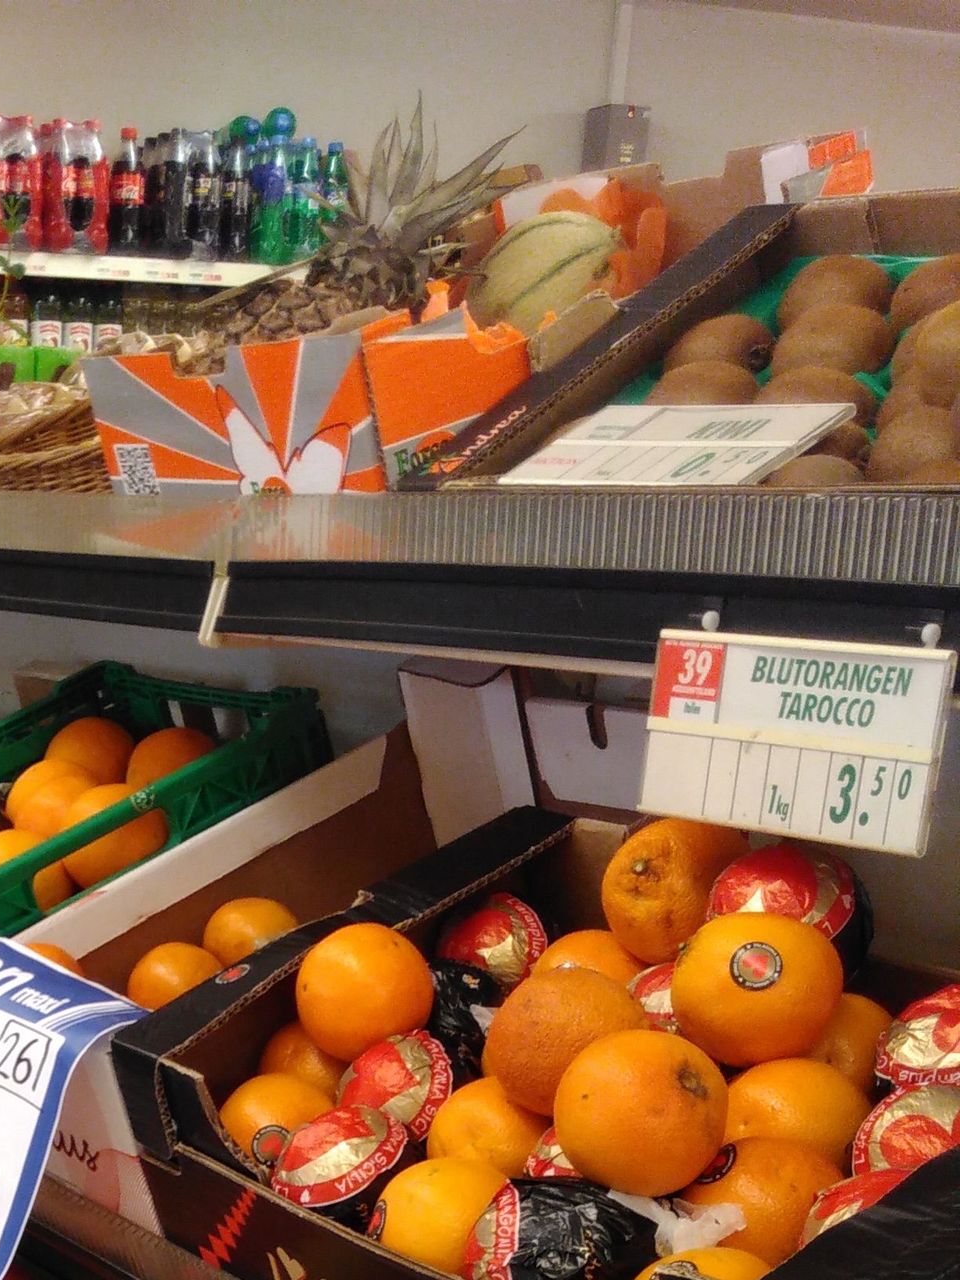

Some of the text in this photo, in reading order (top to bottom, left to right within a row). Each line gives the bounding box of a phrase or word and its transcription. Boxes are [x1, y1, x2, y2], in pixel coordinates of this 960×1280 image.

[678, 649, 714, 686] 39
[751, 655, 914, 697] BLUTORANGEN
[777, 691, 876, 727] TAROCCO
[11, 986, 72, 1015] maxi
